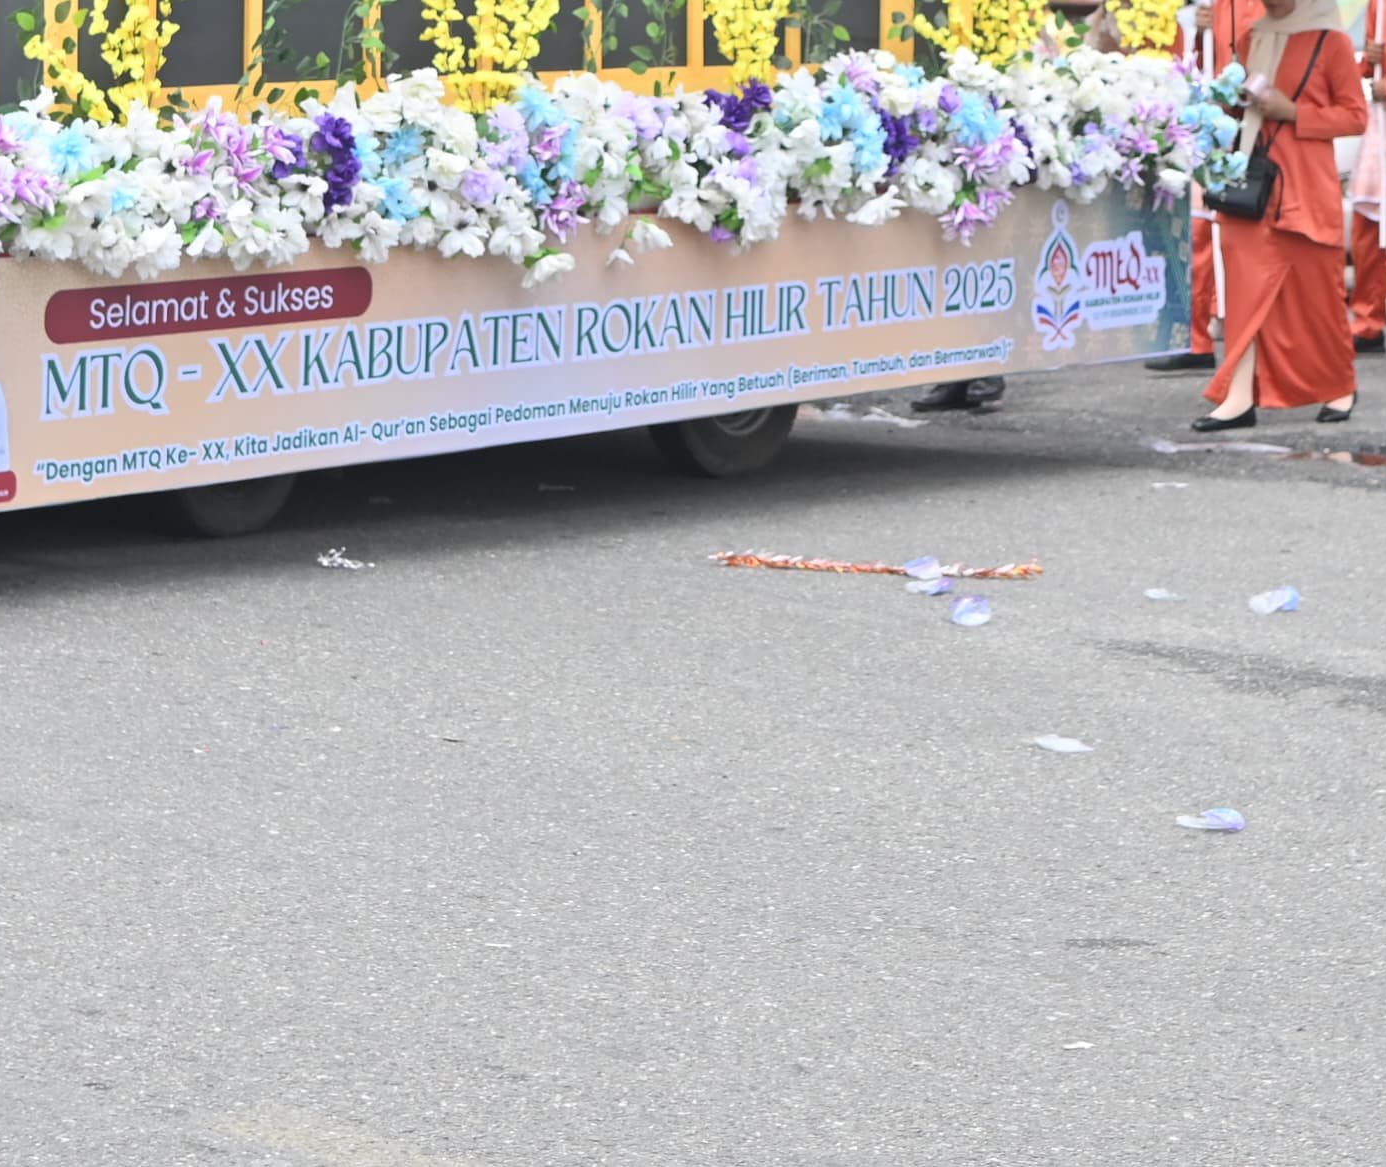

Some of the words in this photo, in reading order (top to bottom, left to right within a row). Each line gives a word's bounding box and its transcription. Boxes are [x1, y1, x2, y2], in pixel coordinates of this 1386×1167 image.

[46, 349, 163, 414] MTQ
[216, 336, 287, 397] XX
[303, 310, 562, 386] KABUPATEN
[576, 294, 713, 356] ROKAN
[726, 284, 806, 339] HILIR
[819, 270, 933, 326] TAHUN
[945, 263, 1013, 312] 2025
[89, 291, 209, 329] Selamat
[215, 288, 236, 318] &
[244, 283, 334, 316] Sukses
[123, 449, 162, 472] MTQ
[166, 446, 197, 466] Ke-
[202, 441, 230, 462] XX,
[235, 437, 268, 457] Kita
[272, 428, 339, 452] Jadikan
[343, 423, 367, 443] Al-
[429, 408, 492, 433] Sebagai
[496, 401, 565, 424] Pedoman
[569, 394, 622, 416] Menuju
[625, 388, 667, 407] Rokan
[671, 383, 697, 402] Hilir
[701, 378, 735, 399] Yang
[738, 370, 784, 392] Betuah
[788, 363, 849, 389] (Beriman,
[853, 356, 906, 376] Tumbuh,
[909, 352, 933, 368] dan
